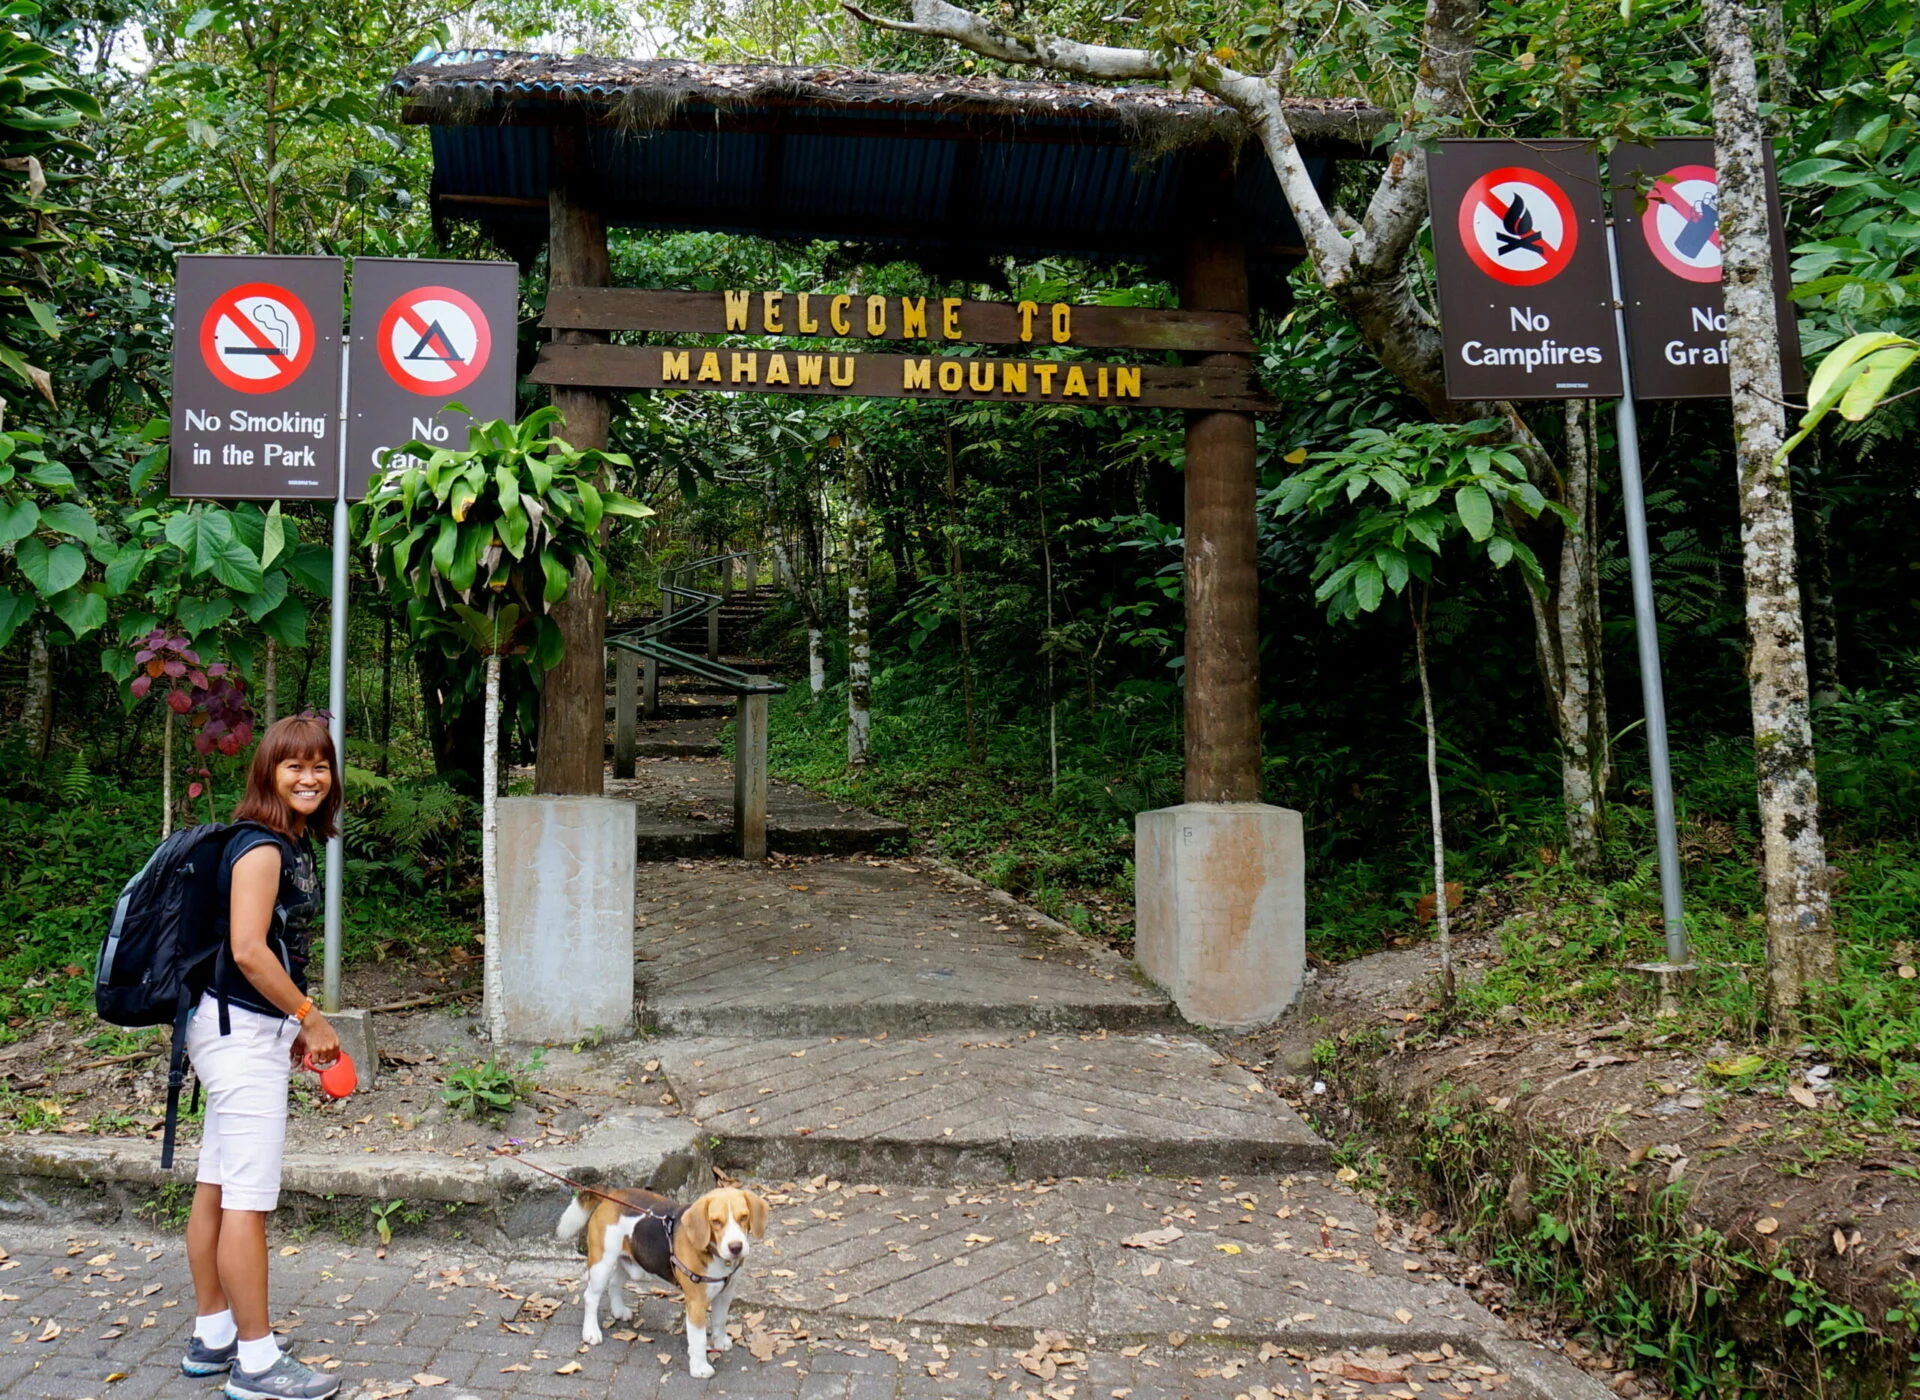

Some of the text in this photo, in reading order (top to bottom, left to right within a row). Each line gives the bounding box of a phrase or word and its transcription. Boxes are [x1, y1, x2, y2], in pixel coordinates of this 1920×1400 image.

[724, 289, 1071, 344] WELCOME TO
[1509, 306, 1550, 332] No
[1691, 307, 1728, 332] No
[1461, 340, 1603, 373] Campfires
[1664, 339, 1728, 365] Graf
[662, 351, 1142, 399] MAHAWU MOUNTAIN
[185, 408, 325, 439] No Smoking
[412, 416, 449, 442] No
[193, 442, 316, 467] in the Park
